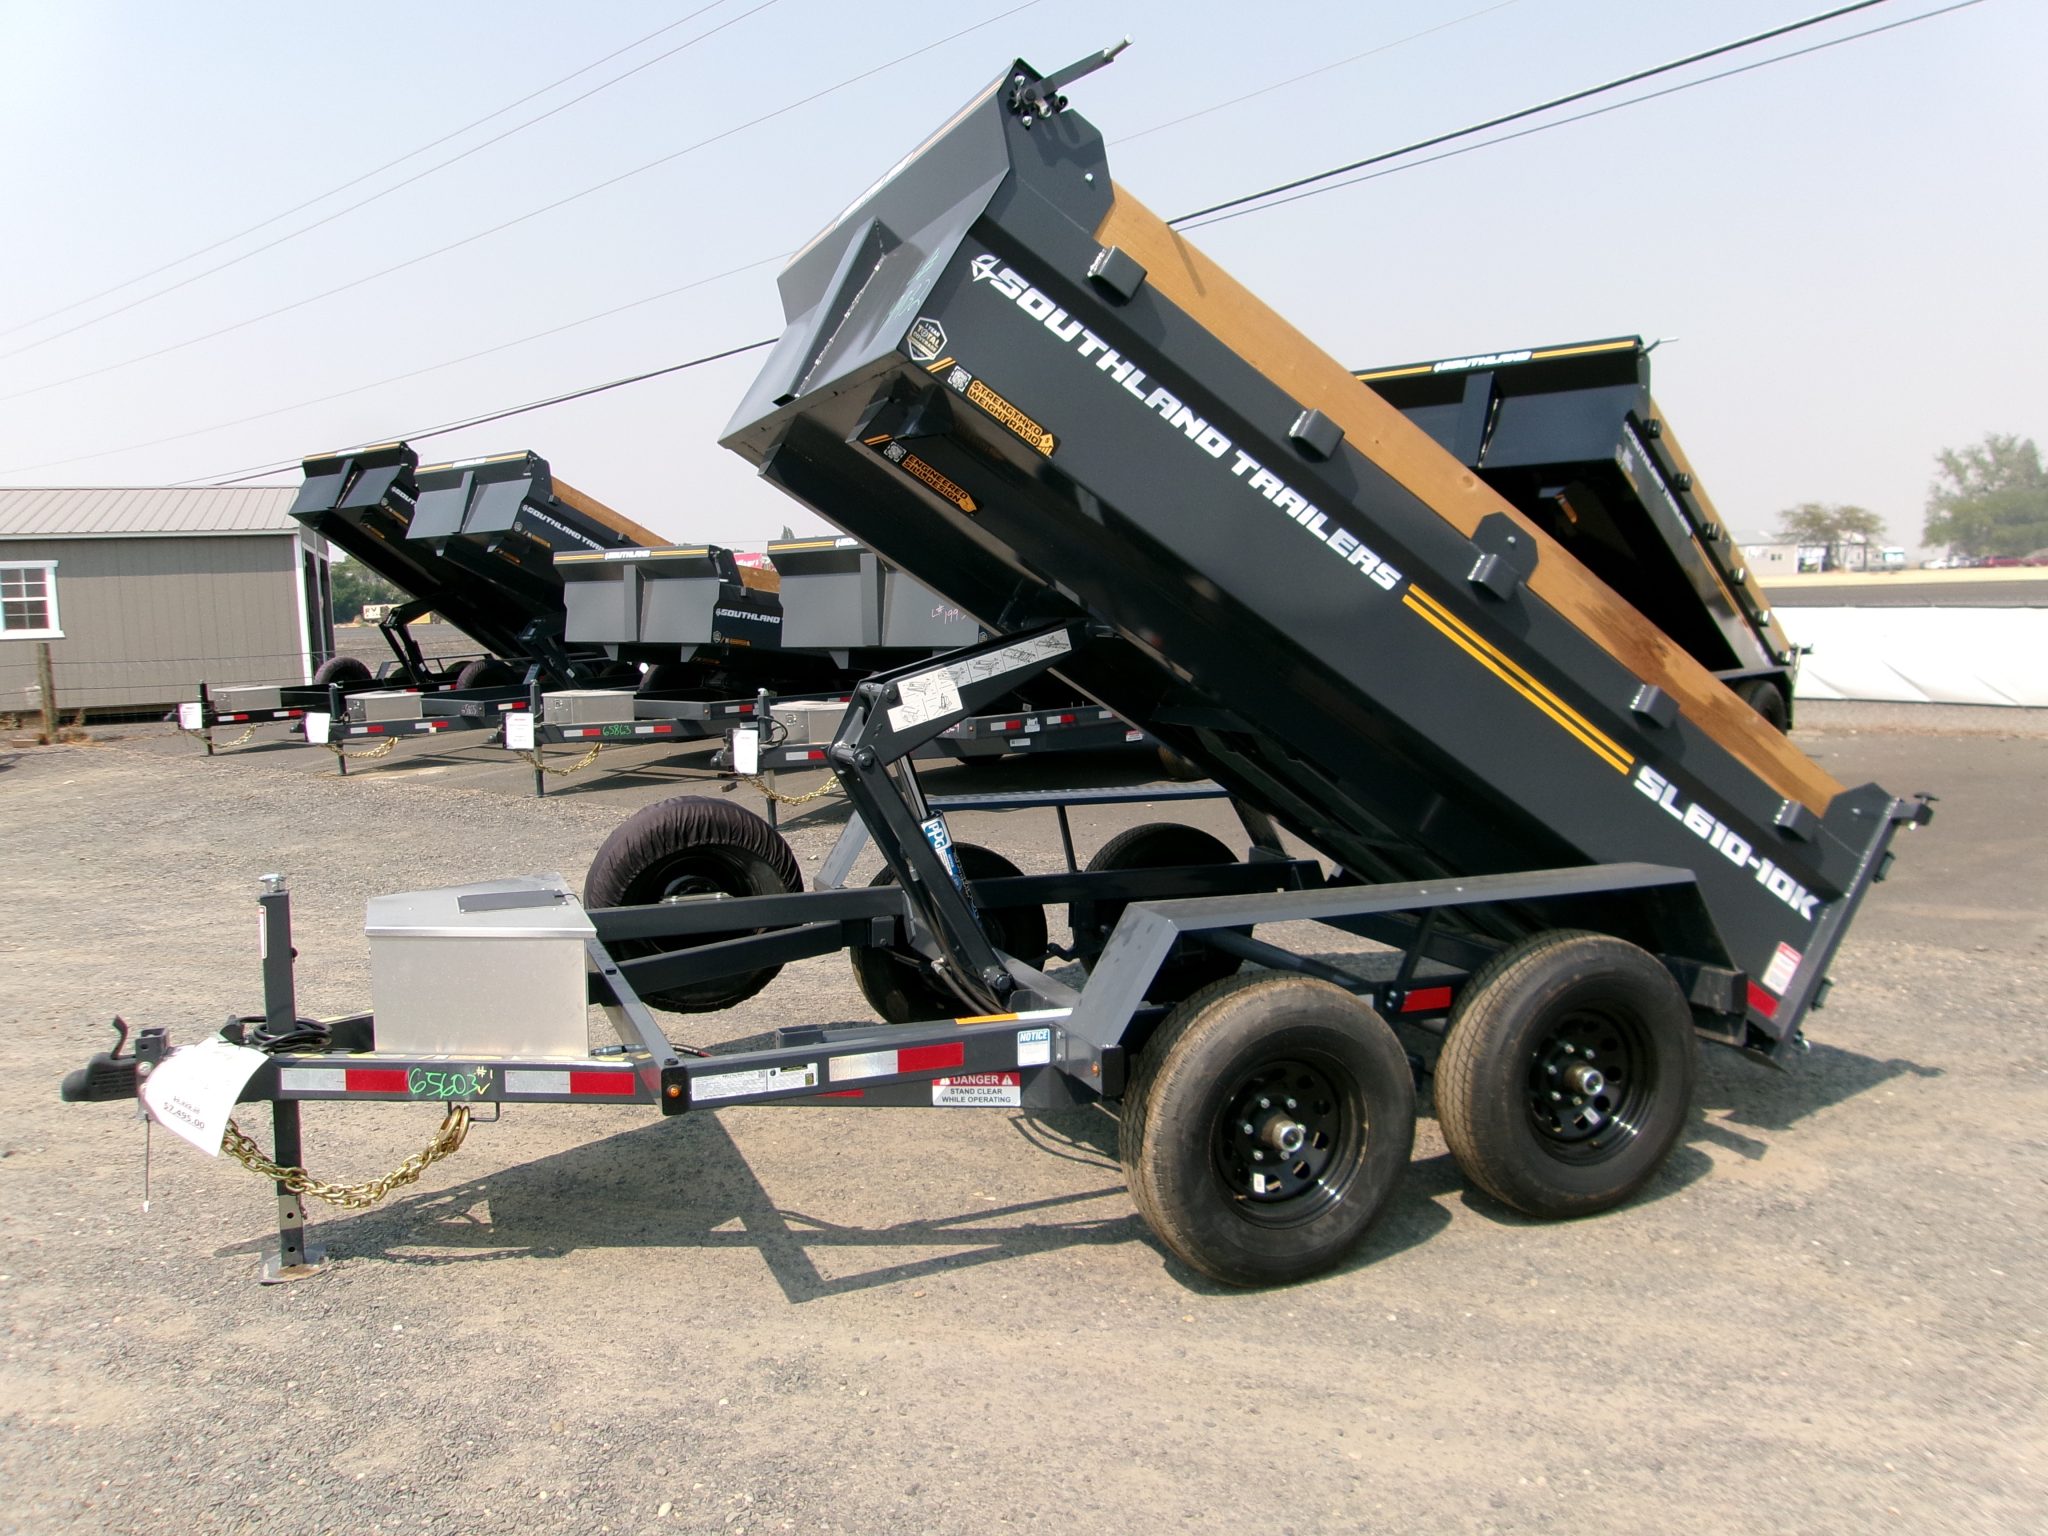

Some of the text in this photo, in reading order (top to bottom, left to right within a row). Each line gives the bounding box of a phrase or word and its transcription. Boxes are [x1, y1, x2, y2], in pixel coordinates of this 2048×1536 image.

[968, 389, 1040, 446] WEIGHT RATIO
[972, 382, 1027, 426] STRENGTH
[991, 268, 1232, 459] SOUTHLAND
[1231, 449, 1402, 592] TRAILERS
[908, 455, 968, 500] ENGINEERED
[926, 475, 961, 503] DESIGN
[719, 608, 780, 624] SOUTHLAND
[927, 821, 946, 849] PPG
[1634, 765, 1820, 921] SL610-10K
[1020, 1031, 1048, 1041] NOTICE
[953, 1075, 999, 1085] DANGER
